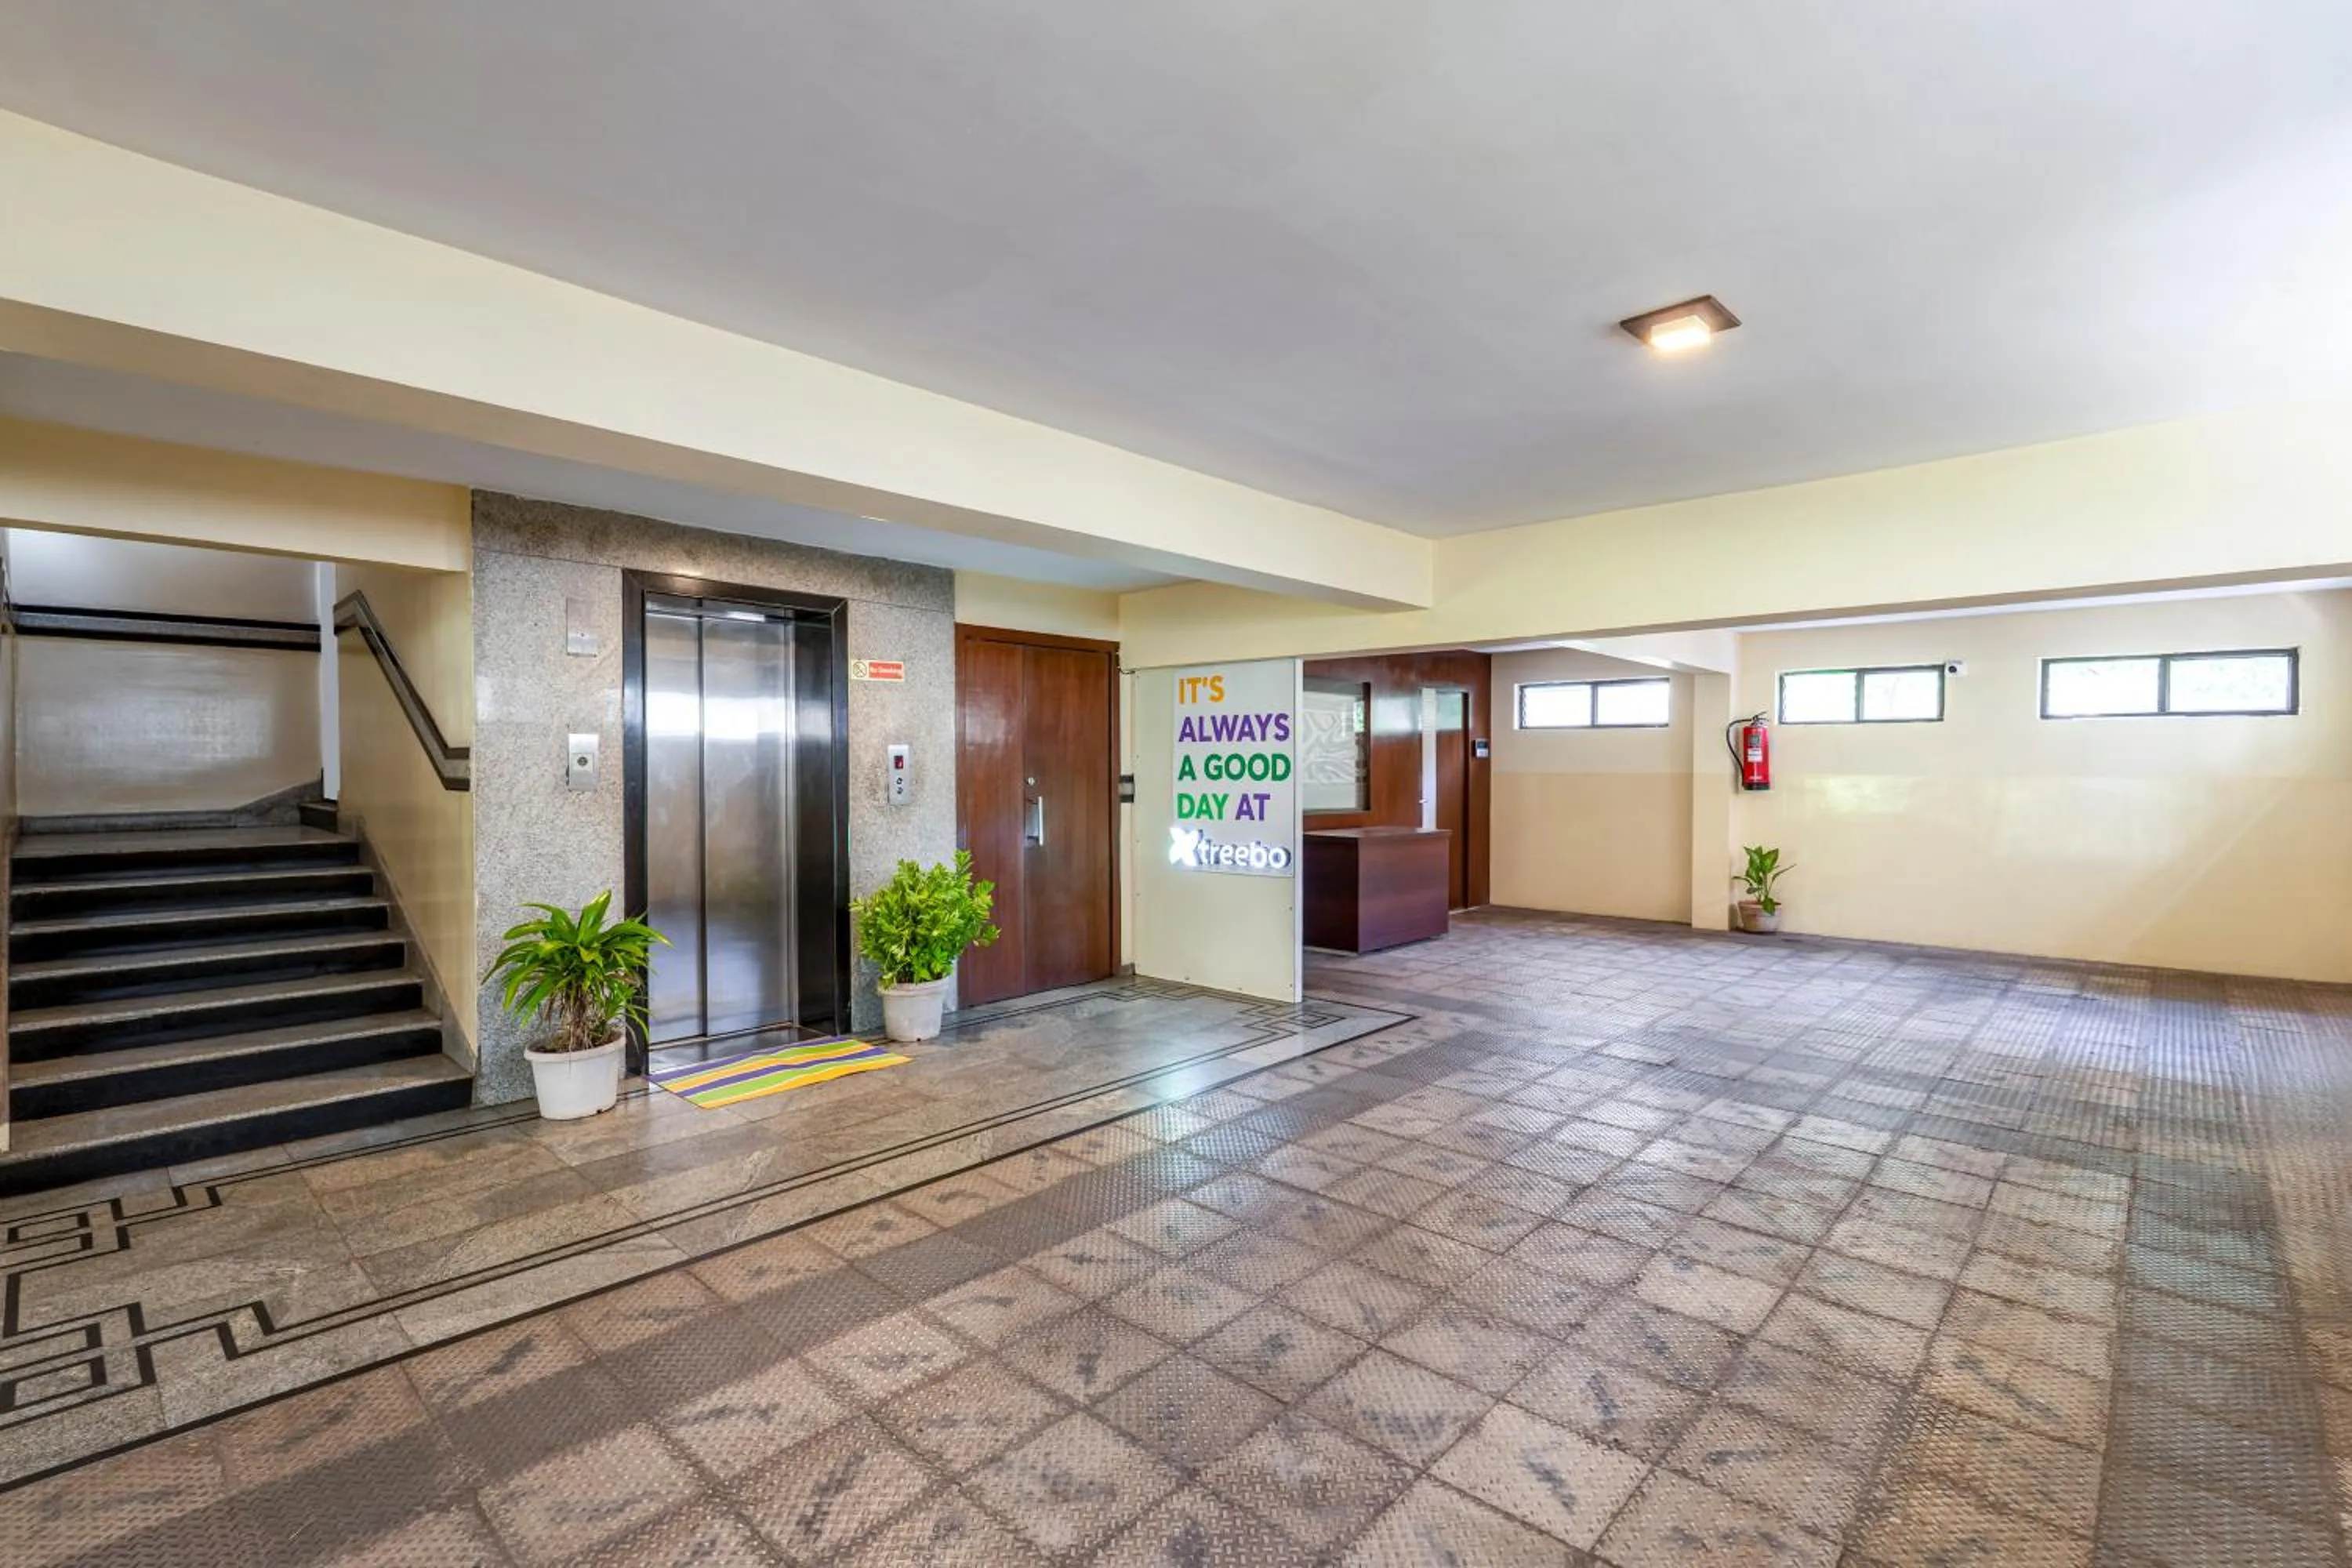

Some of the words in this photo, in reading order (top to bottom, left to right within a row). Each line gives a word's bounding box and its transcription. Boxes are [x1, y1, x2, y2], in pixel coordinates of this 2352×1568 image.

[1178, 675, 1225, 705] IT'S
[1178, 713, 1290, 742] ALWAYS
[1178, 754, 1196, 781] A
[1203, 753, 1291, 782] GOOD
[1177, 793, 1229, 820] DAY
[1235, 793, 1271, 821] AT
[1198, 838, 1290, 869] treebo
